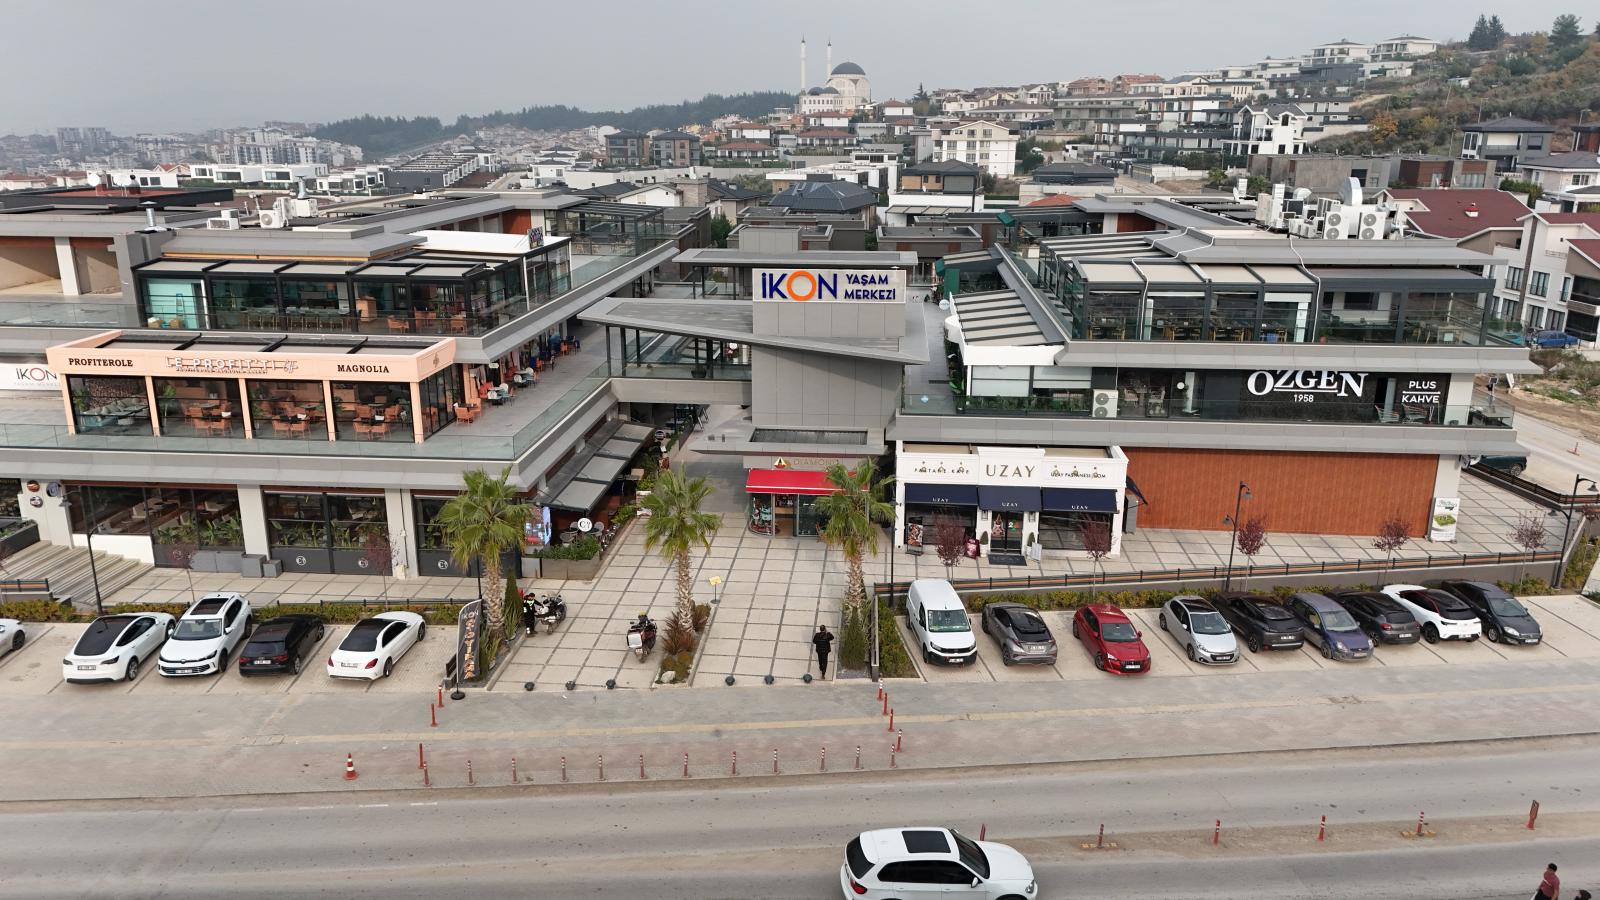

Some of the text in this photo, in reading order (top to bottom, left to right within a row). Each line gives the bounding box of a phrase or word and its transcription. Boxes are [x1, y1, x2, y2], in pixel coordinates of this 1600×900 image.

[846, 273, 889, 286] YAŞAM
[761, 270, 838, 302] İKON
[844, 288, 896, 300] MERKEZİ
[68, 357, 133, 367] PROFITEROLE
[337, 364, 390, 374] MAGNOLIA
[1408, 380, 1437, 390] PLUS
[1294, 394, 1314, 403] 1958
[1401, 394, 1440, 404] KAHVE
[986, 464, 1036, 478] UZAY
